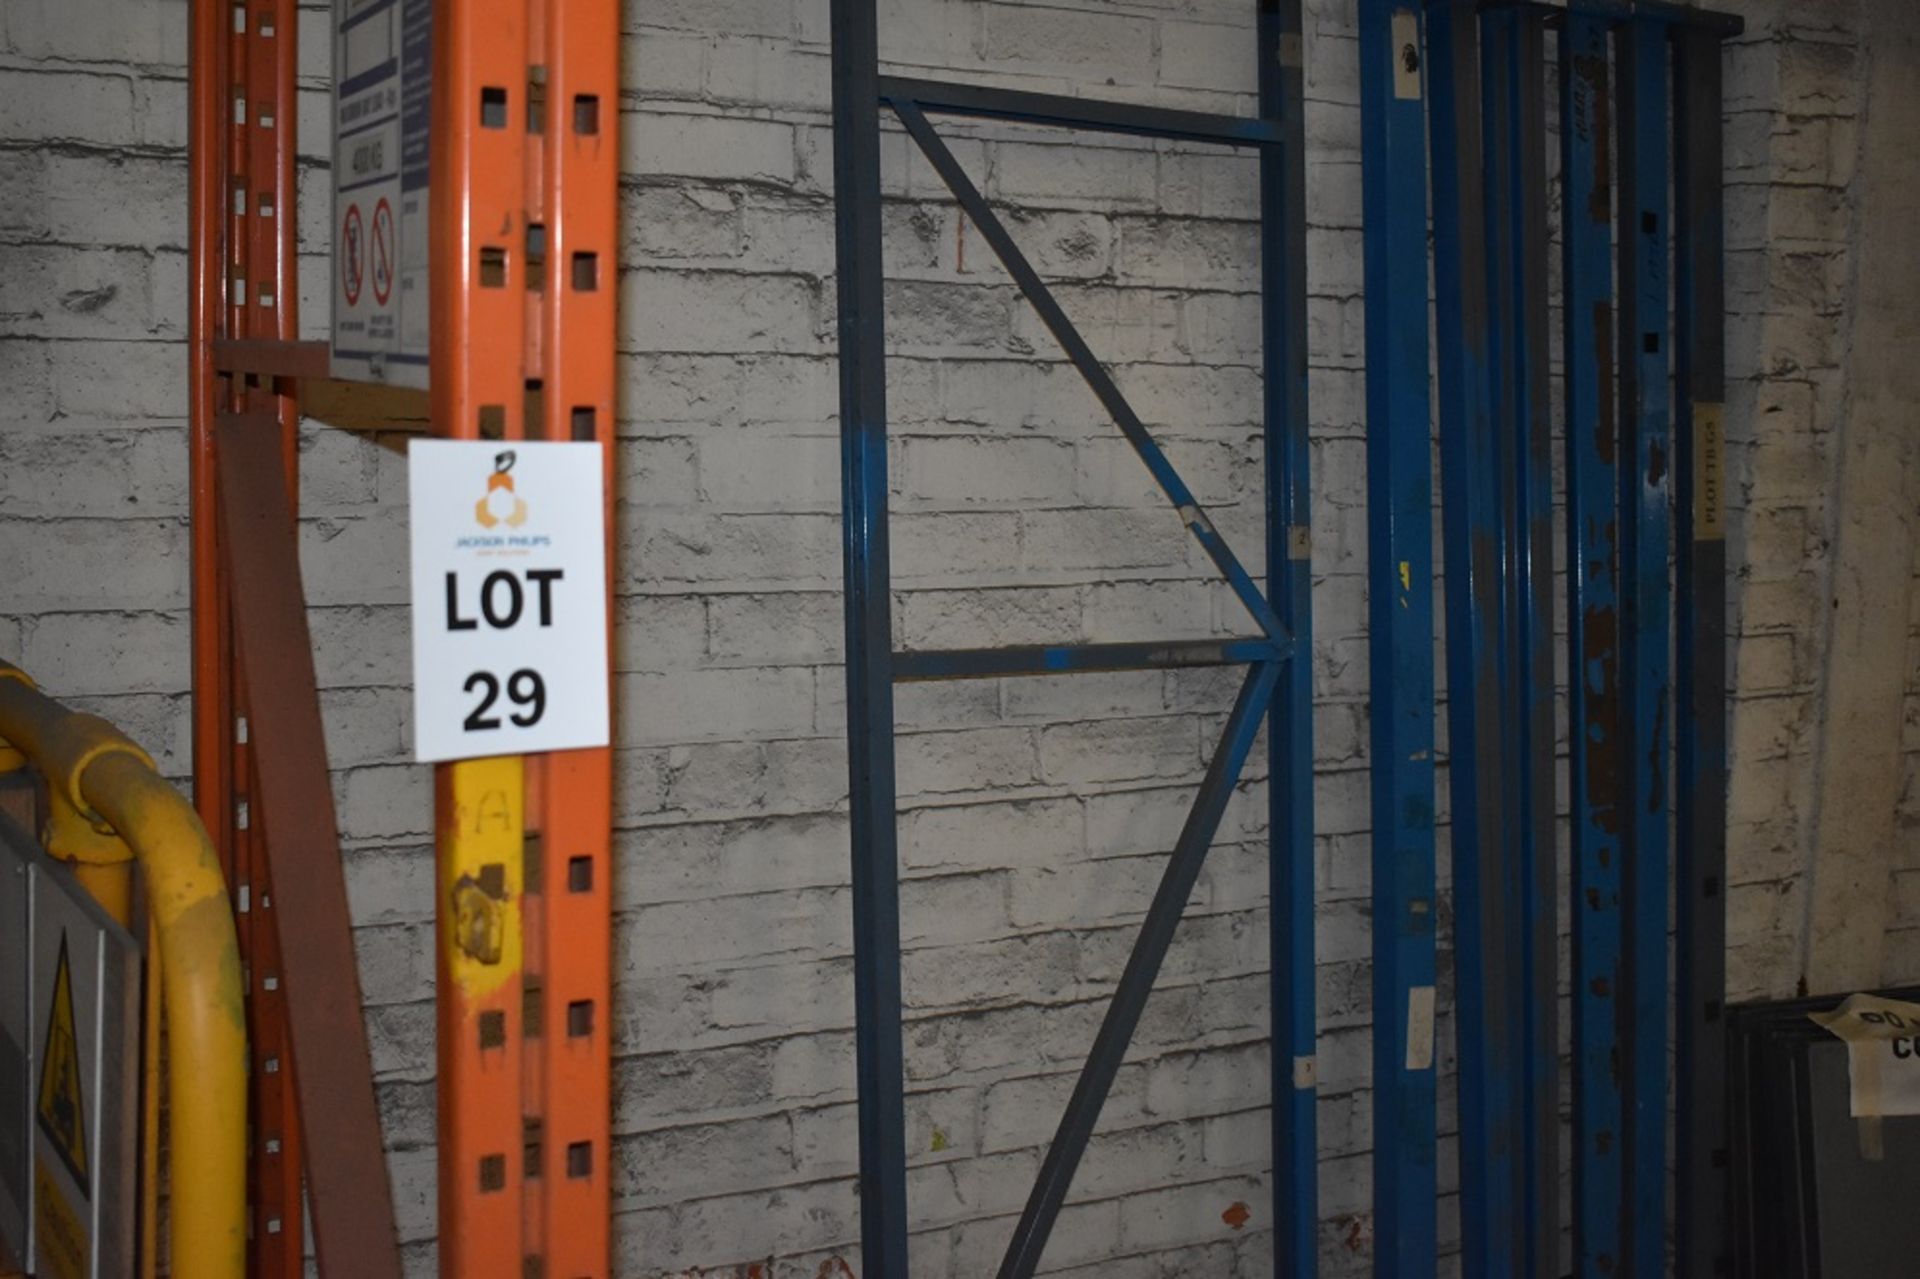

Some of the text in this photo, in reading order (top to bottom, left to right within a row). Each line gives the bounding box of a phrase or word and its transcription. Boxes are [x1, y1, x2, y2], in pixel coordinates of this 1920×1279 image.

[455, 535, 504, 549] JACKSON
[446, 571, 563, 630] LOT
[463, 669, 545, 731] 29
